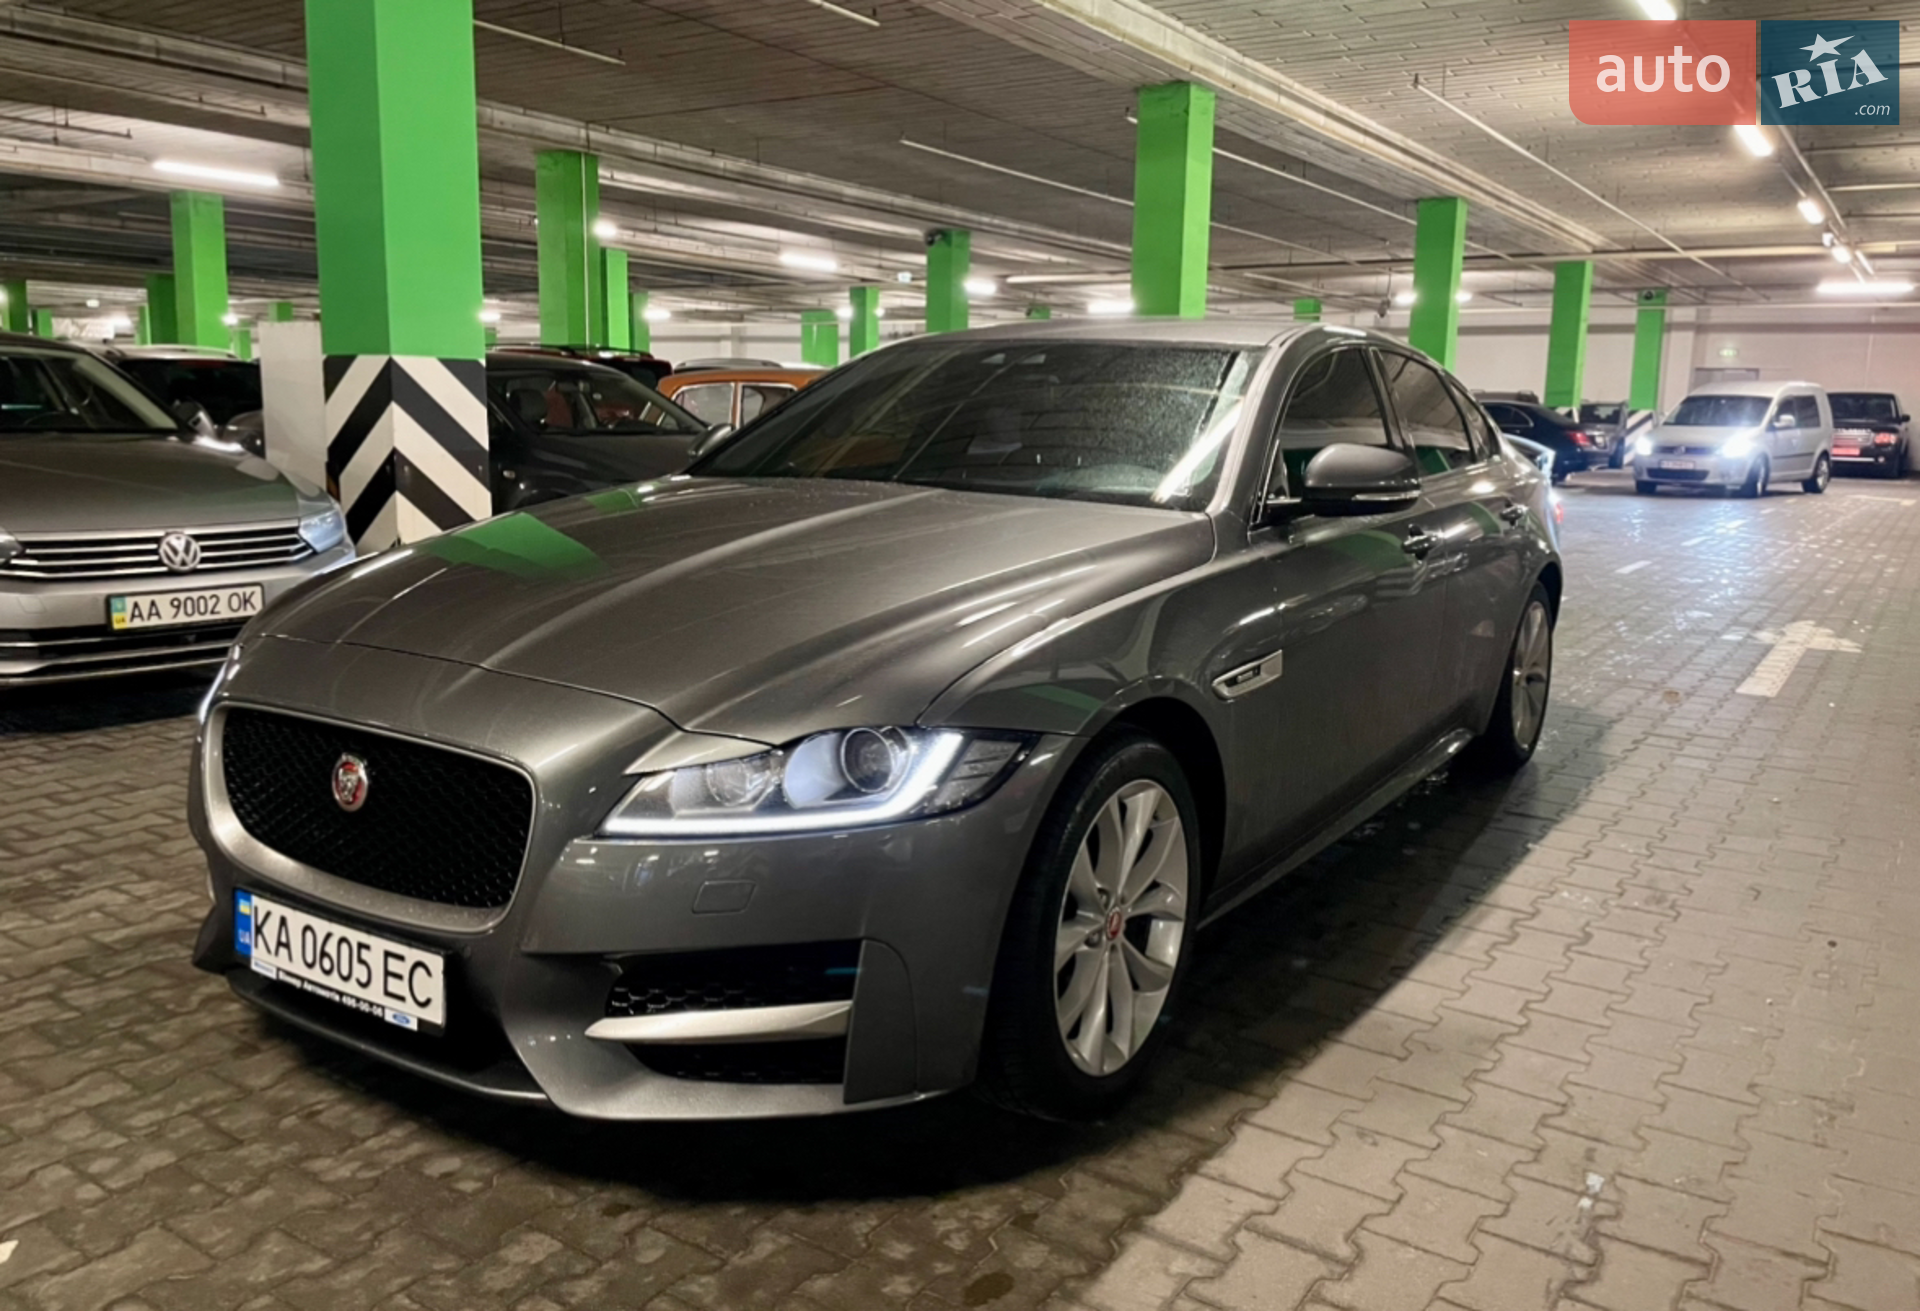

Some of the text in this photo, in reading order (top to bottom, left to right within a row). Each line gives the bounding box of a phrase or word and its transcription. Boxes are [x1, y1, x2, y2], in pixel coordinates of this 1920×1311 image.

[129, 590, 257, 623] AA 9002 OK
[253, 905, 433, 1009] KA 0605 EC
